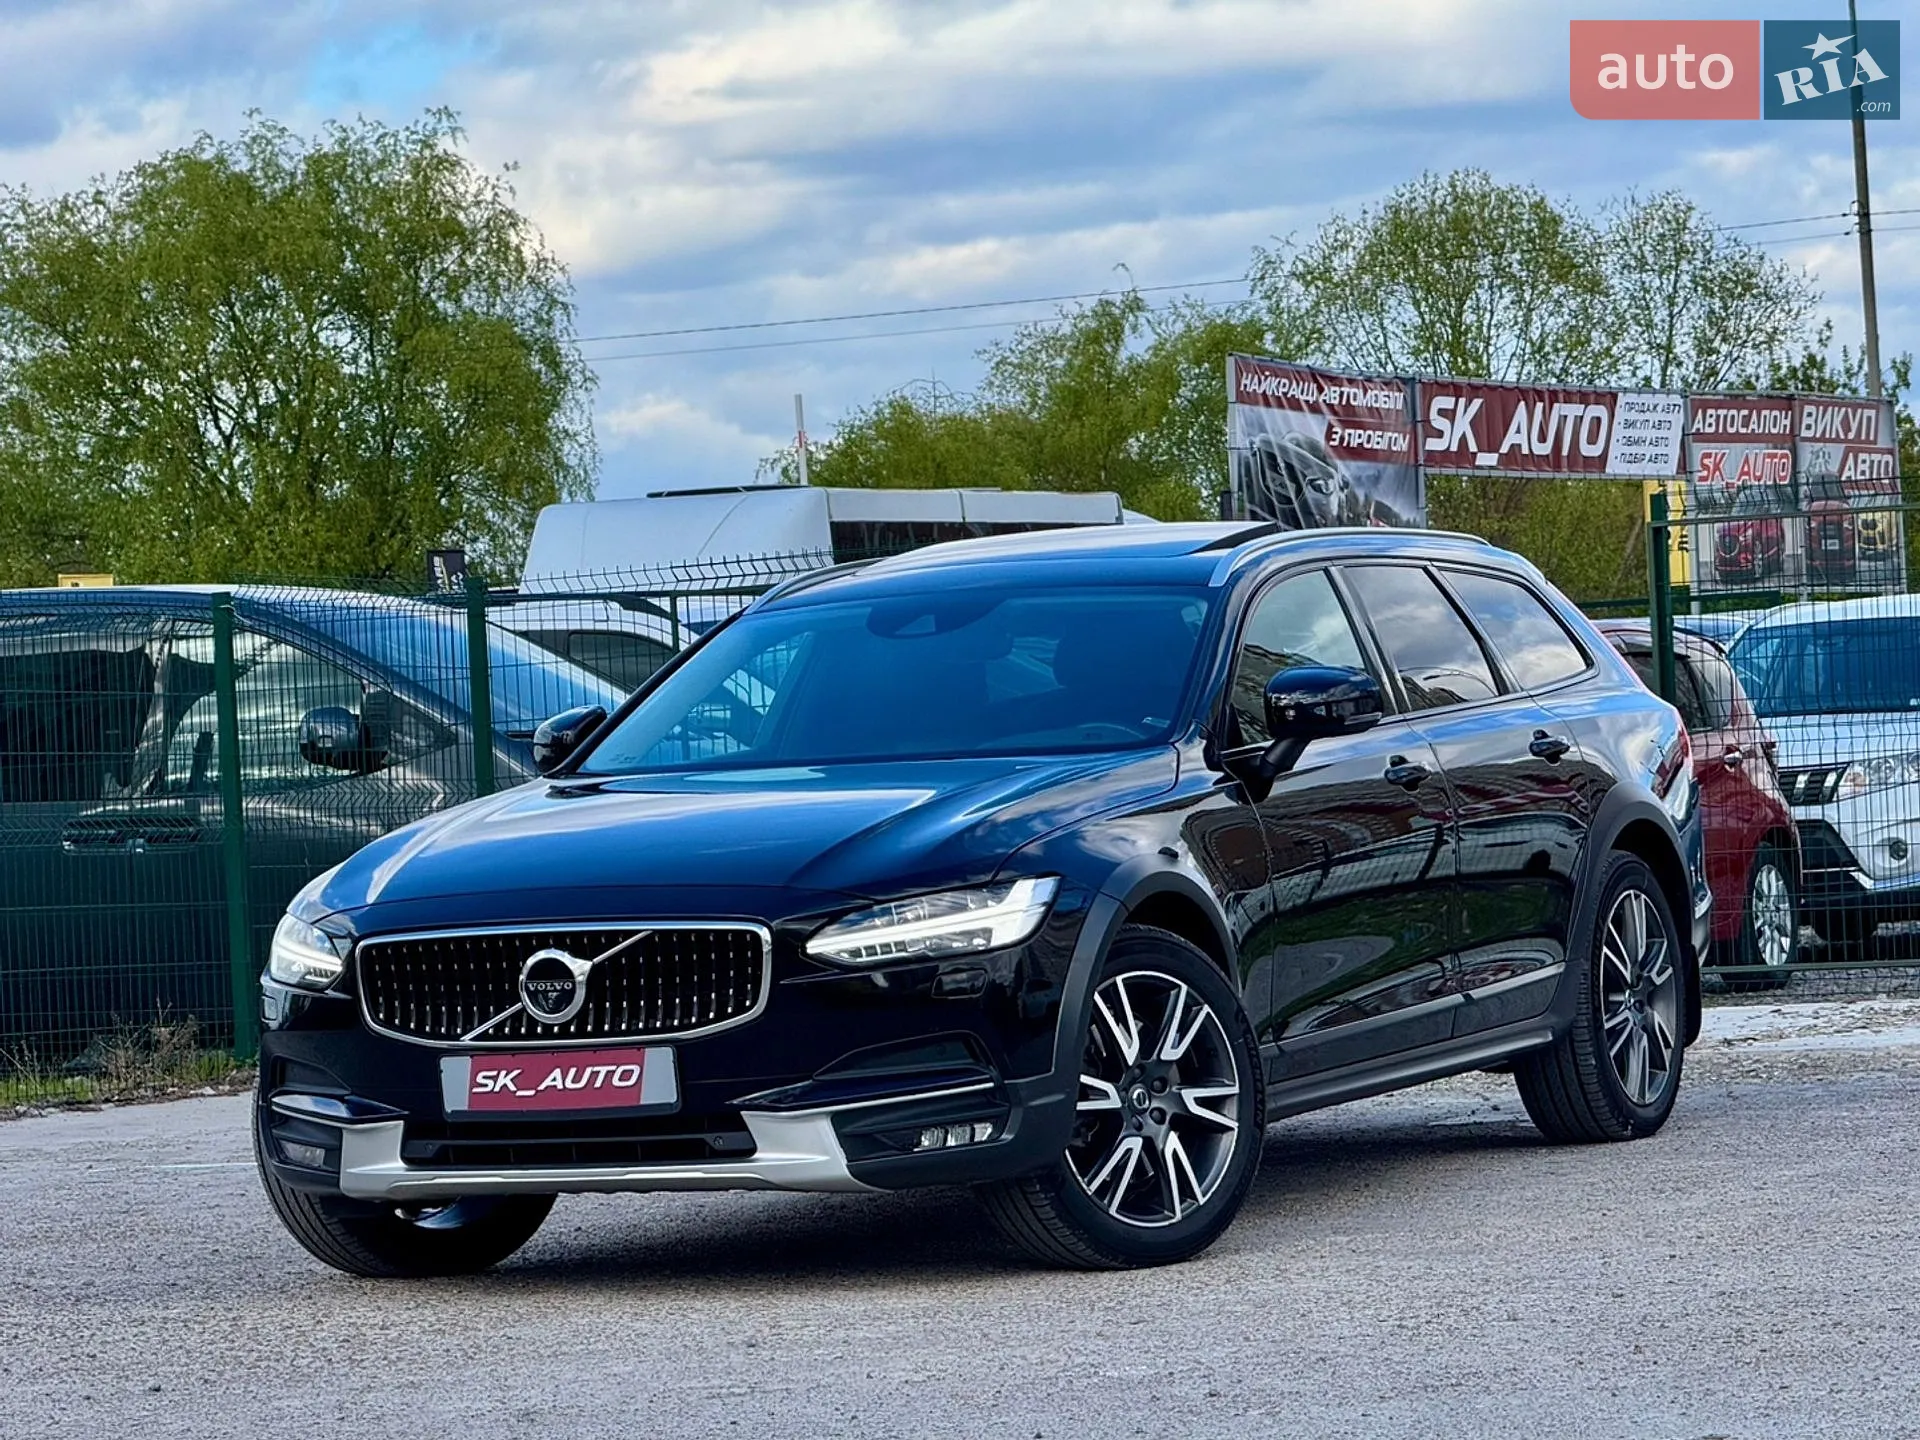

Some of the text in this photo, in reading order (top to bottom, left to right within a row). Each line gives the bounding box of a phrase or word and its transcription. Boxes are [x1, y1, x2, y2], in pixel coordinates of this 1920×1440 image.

[1424, 396, 1609, 466] SK_AUTO
[1692, 408, 1792, 435] АВТОСАЛОН
[1800, 405, 1876, 440] ВИКУП
[1841, 452, 1893, 483] АВТО
[527, 982, 573, 991] VOLVO
[472, 1064, 641, 1097] SK_AUTO
